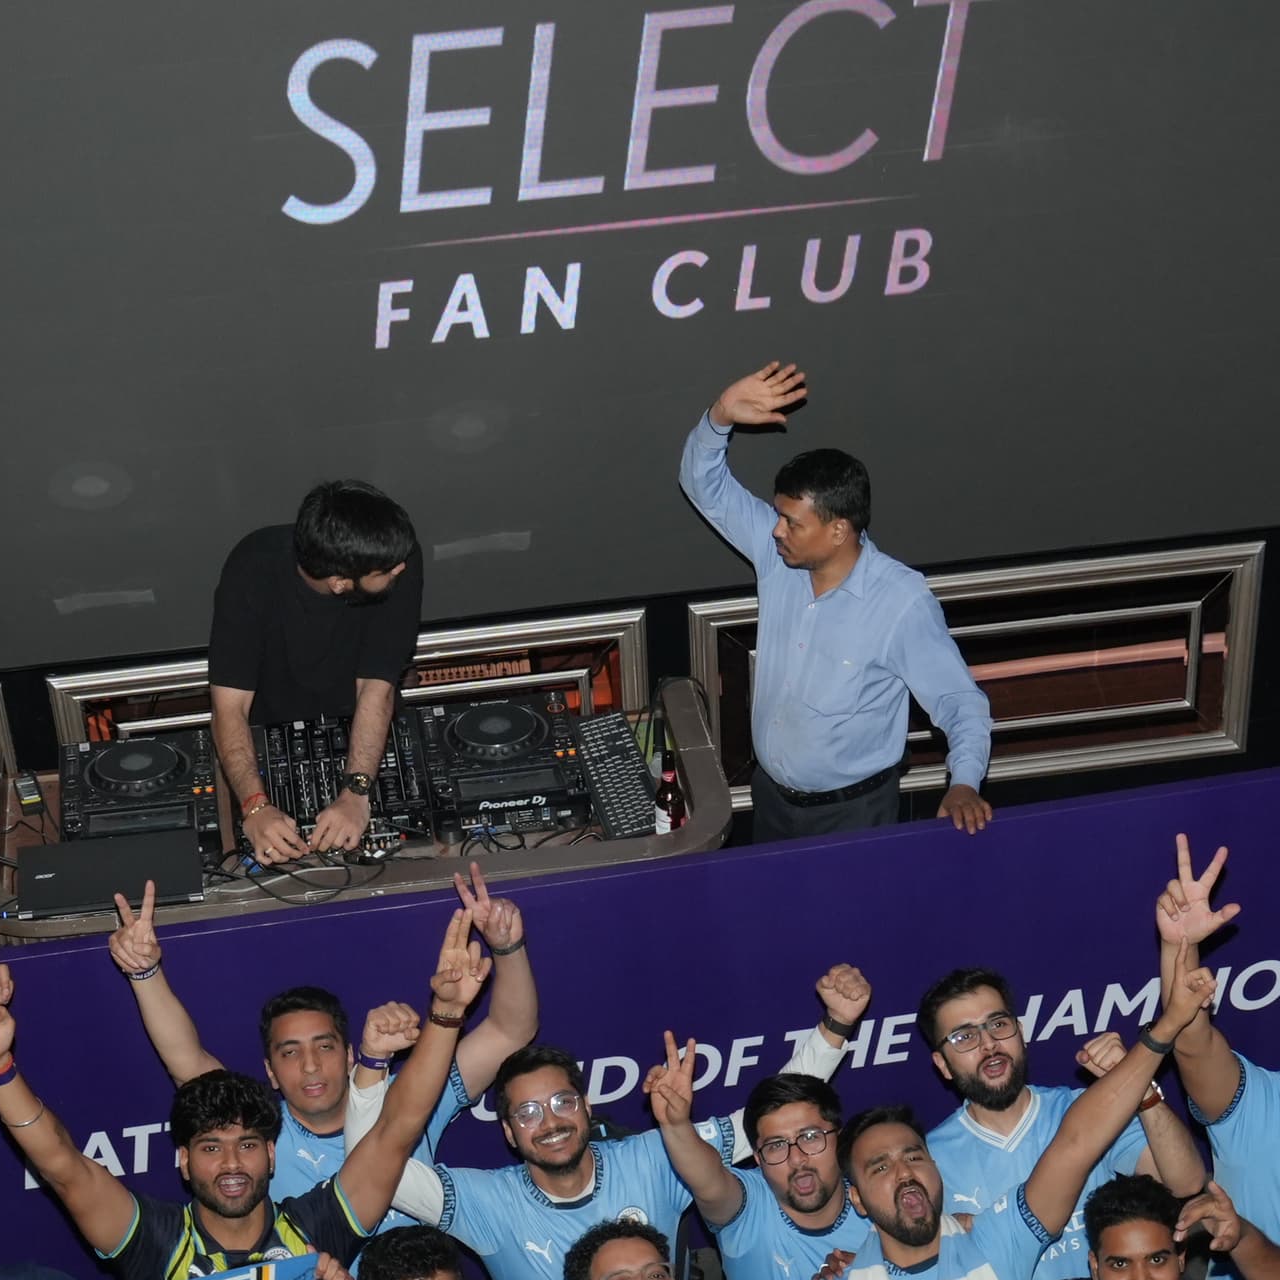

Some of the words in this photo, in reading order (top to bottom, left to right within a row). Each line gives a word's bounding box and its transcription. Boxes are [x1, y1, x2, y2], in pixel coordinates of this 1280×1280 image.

[281, 0, 974, 225] SELECT
[375, 263, 581, 349] FAN
[651, 228, 934, 319] CLUB
[478, 799, 529, 810] Pioneer
[678, 1036, 763, 1091] OF
